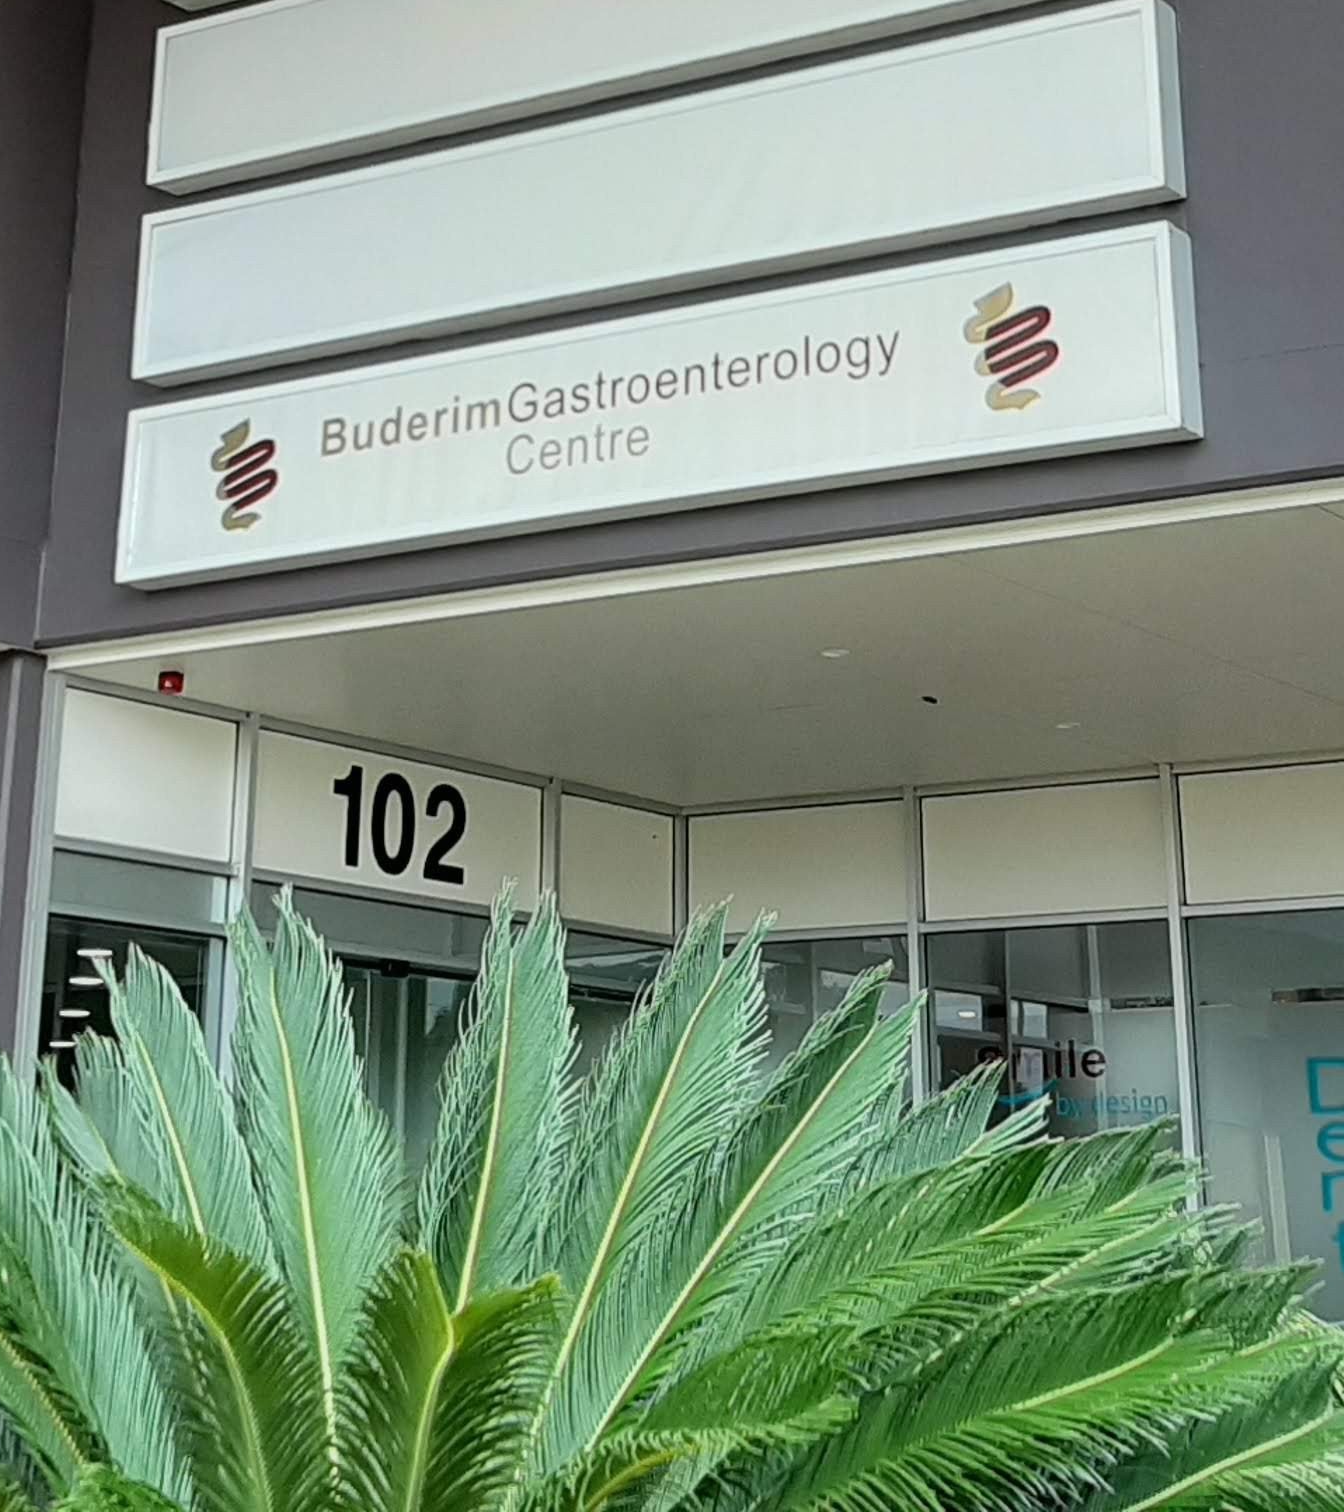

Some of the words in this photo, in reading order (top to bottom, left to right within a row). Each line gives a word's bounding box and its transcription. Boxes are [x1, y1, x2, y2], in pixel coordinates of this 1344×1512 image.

[506, 422, 650, 476] Centre
[333, 764, 467, 885] 102
[1093, 1088, 1168, 1117] design
